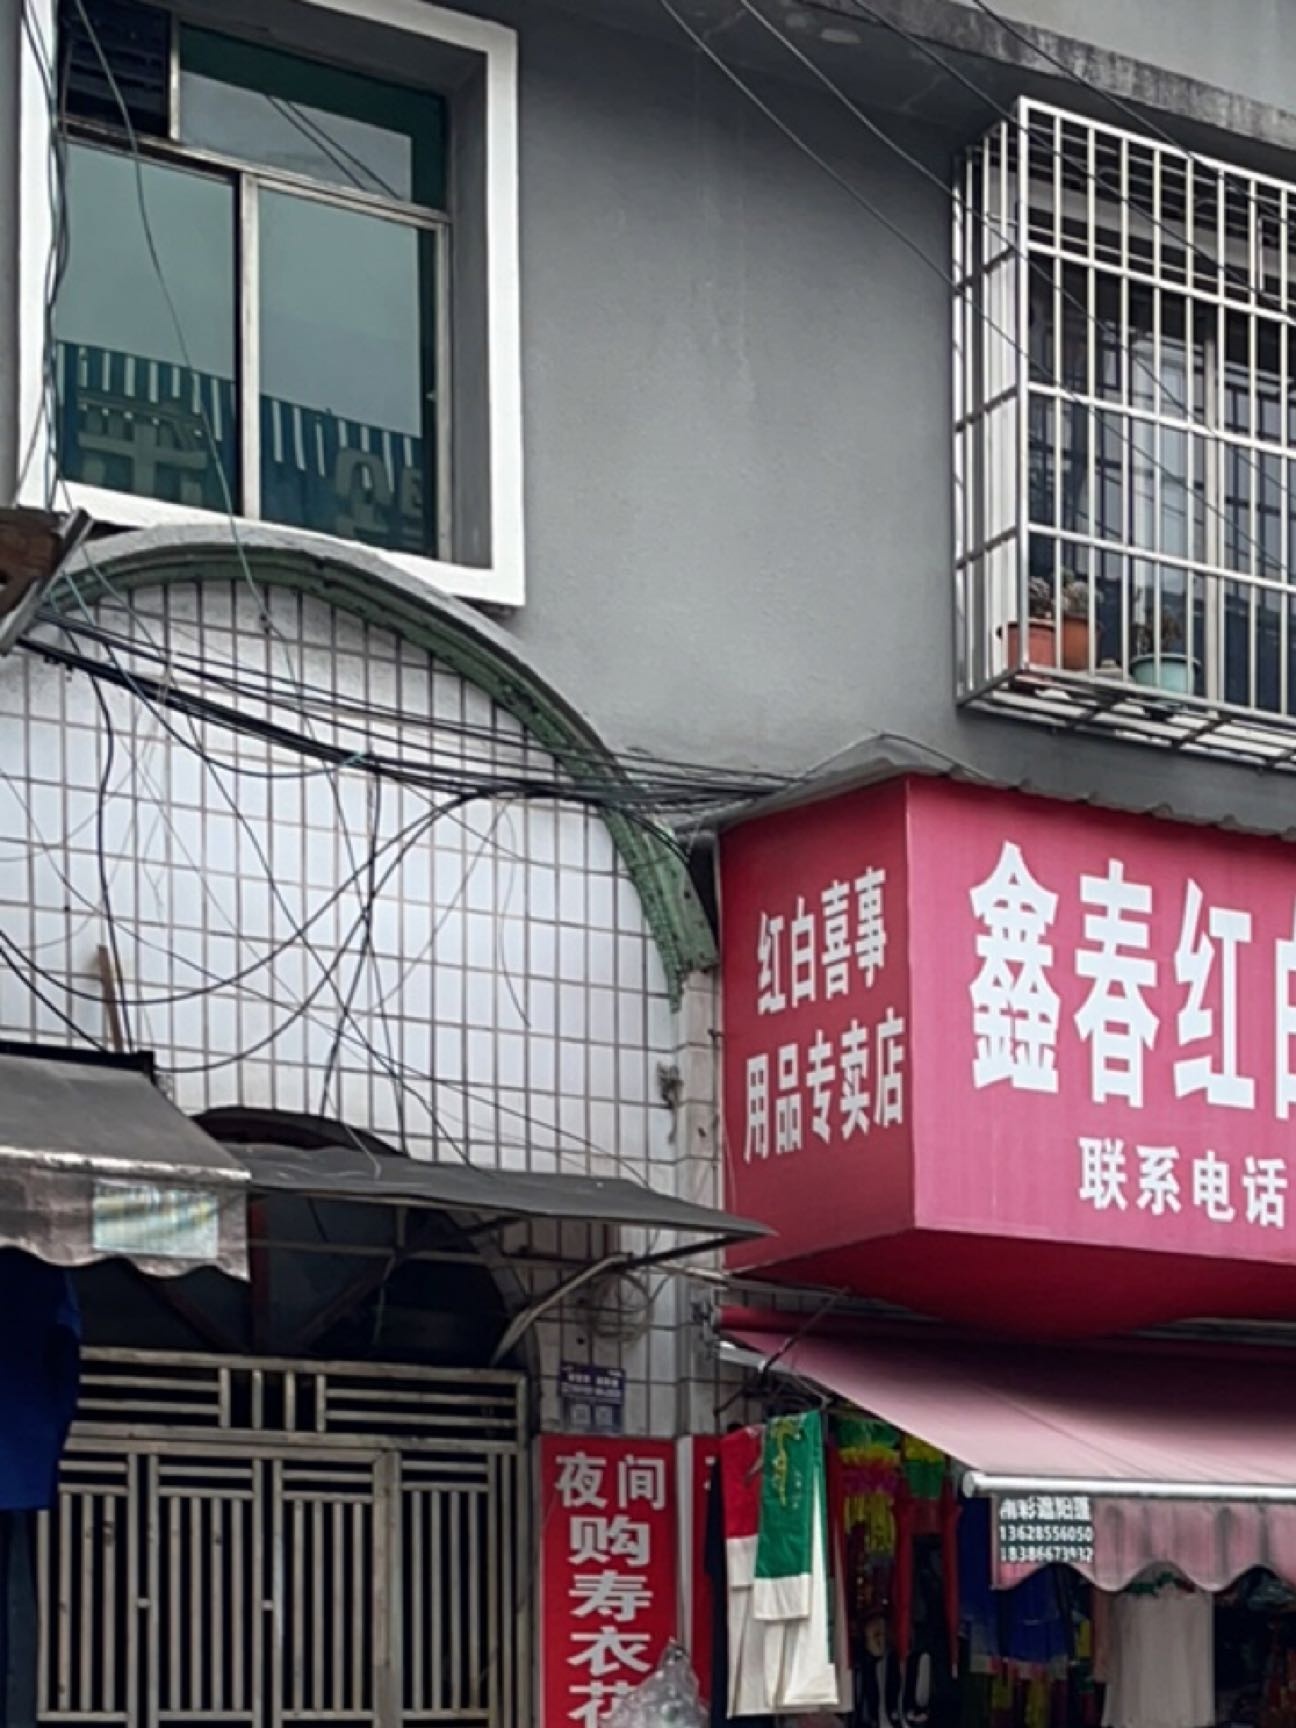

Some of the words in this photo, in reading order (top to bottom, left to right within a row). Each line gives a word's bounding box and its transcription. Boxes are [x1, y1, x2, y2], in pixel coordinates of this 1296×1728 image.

[756, 866, 887, 1015] 红白喜事
[743, 1007, 905, 1162] 用品专卖店
[1078, 1137, 1287, 1228] 联系电话
[555, 1452, 665, 1510] 夜间
